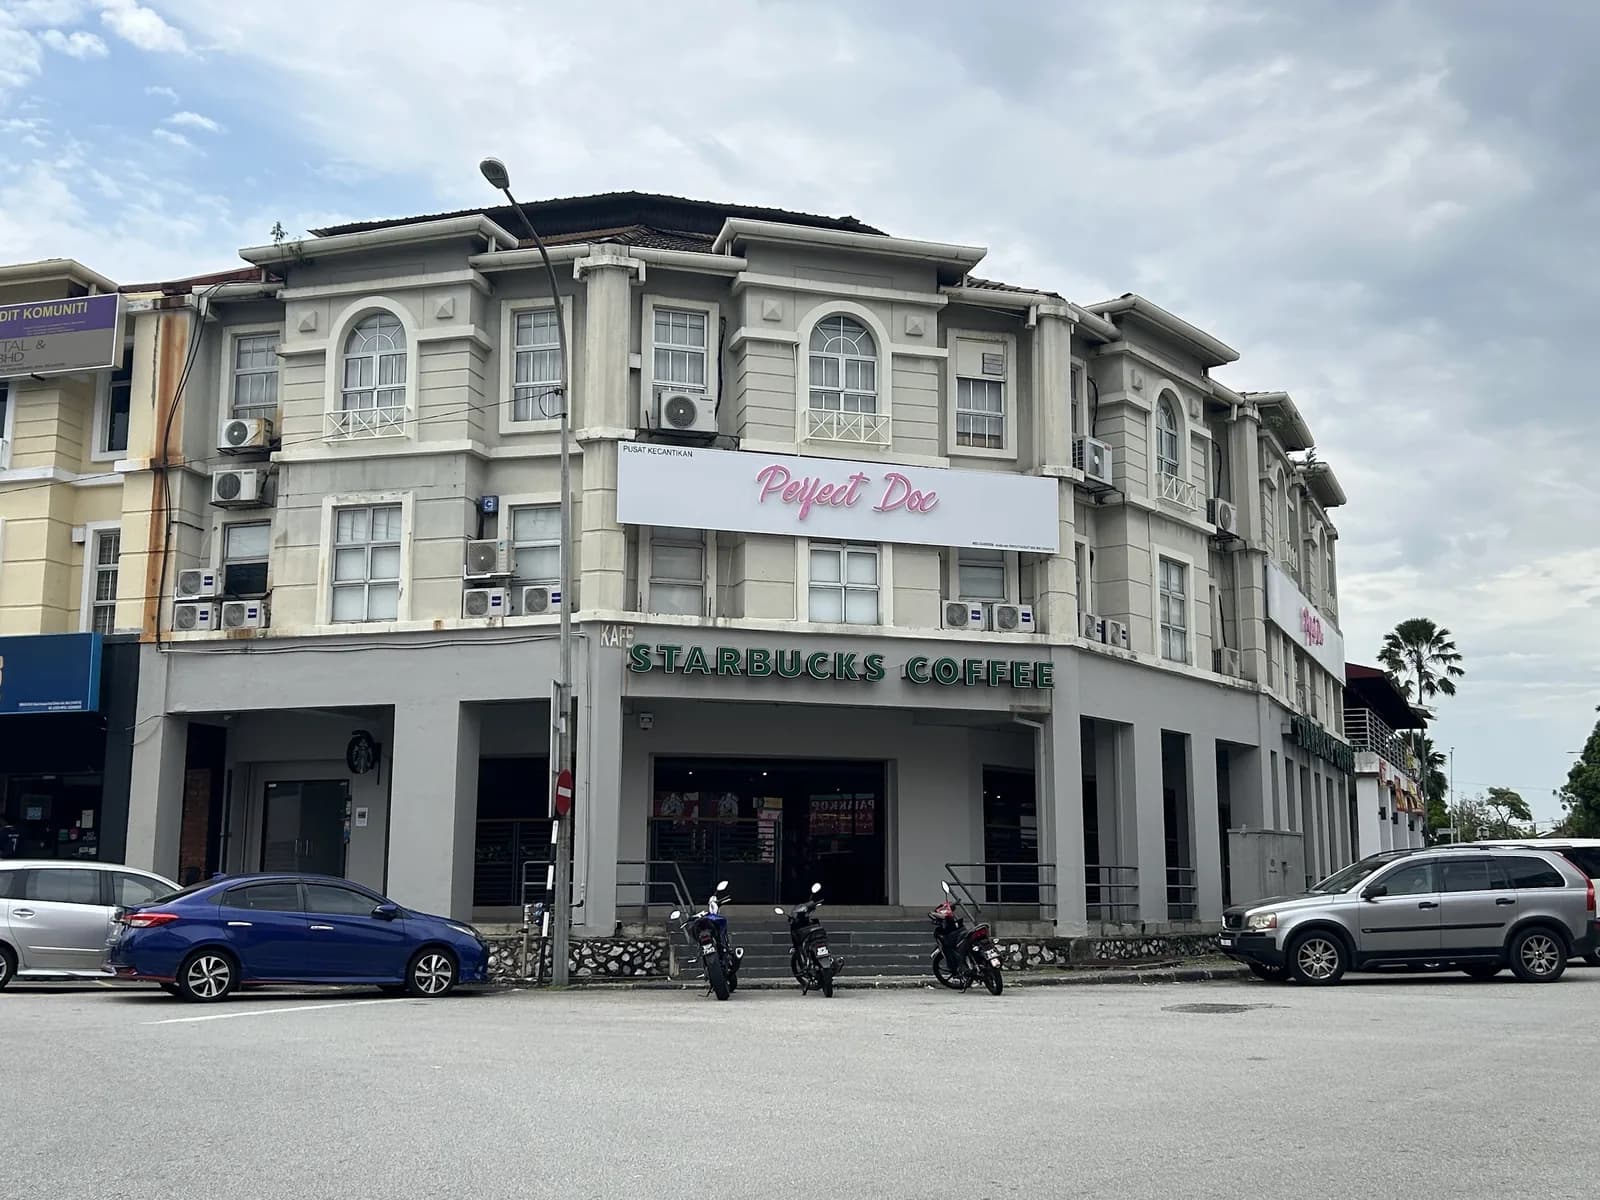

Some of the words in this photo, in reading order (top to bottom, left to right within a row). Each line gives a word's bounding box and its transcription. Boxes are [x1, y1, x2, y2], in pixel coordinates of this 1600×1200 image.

[23, 302, 88, 319] KOMUNITI
[36, 339, 46, 350] &
[623, 445, 646, 453] PUSAT
[647, 447, 693, 457] KECANTIKAN
[755, 464, 872, 521] Perfect
[872, 472, 940, 513] Doc
[600, 624, 634, 649] KAFE
[628, 643, 887, 683] STARBUCKS
[903, 655, 1055, 690] COFFEE
